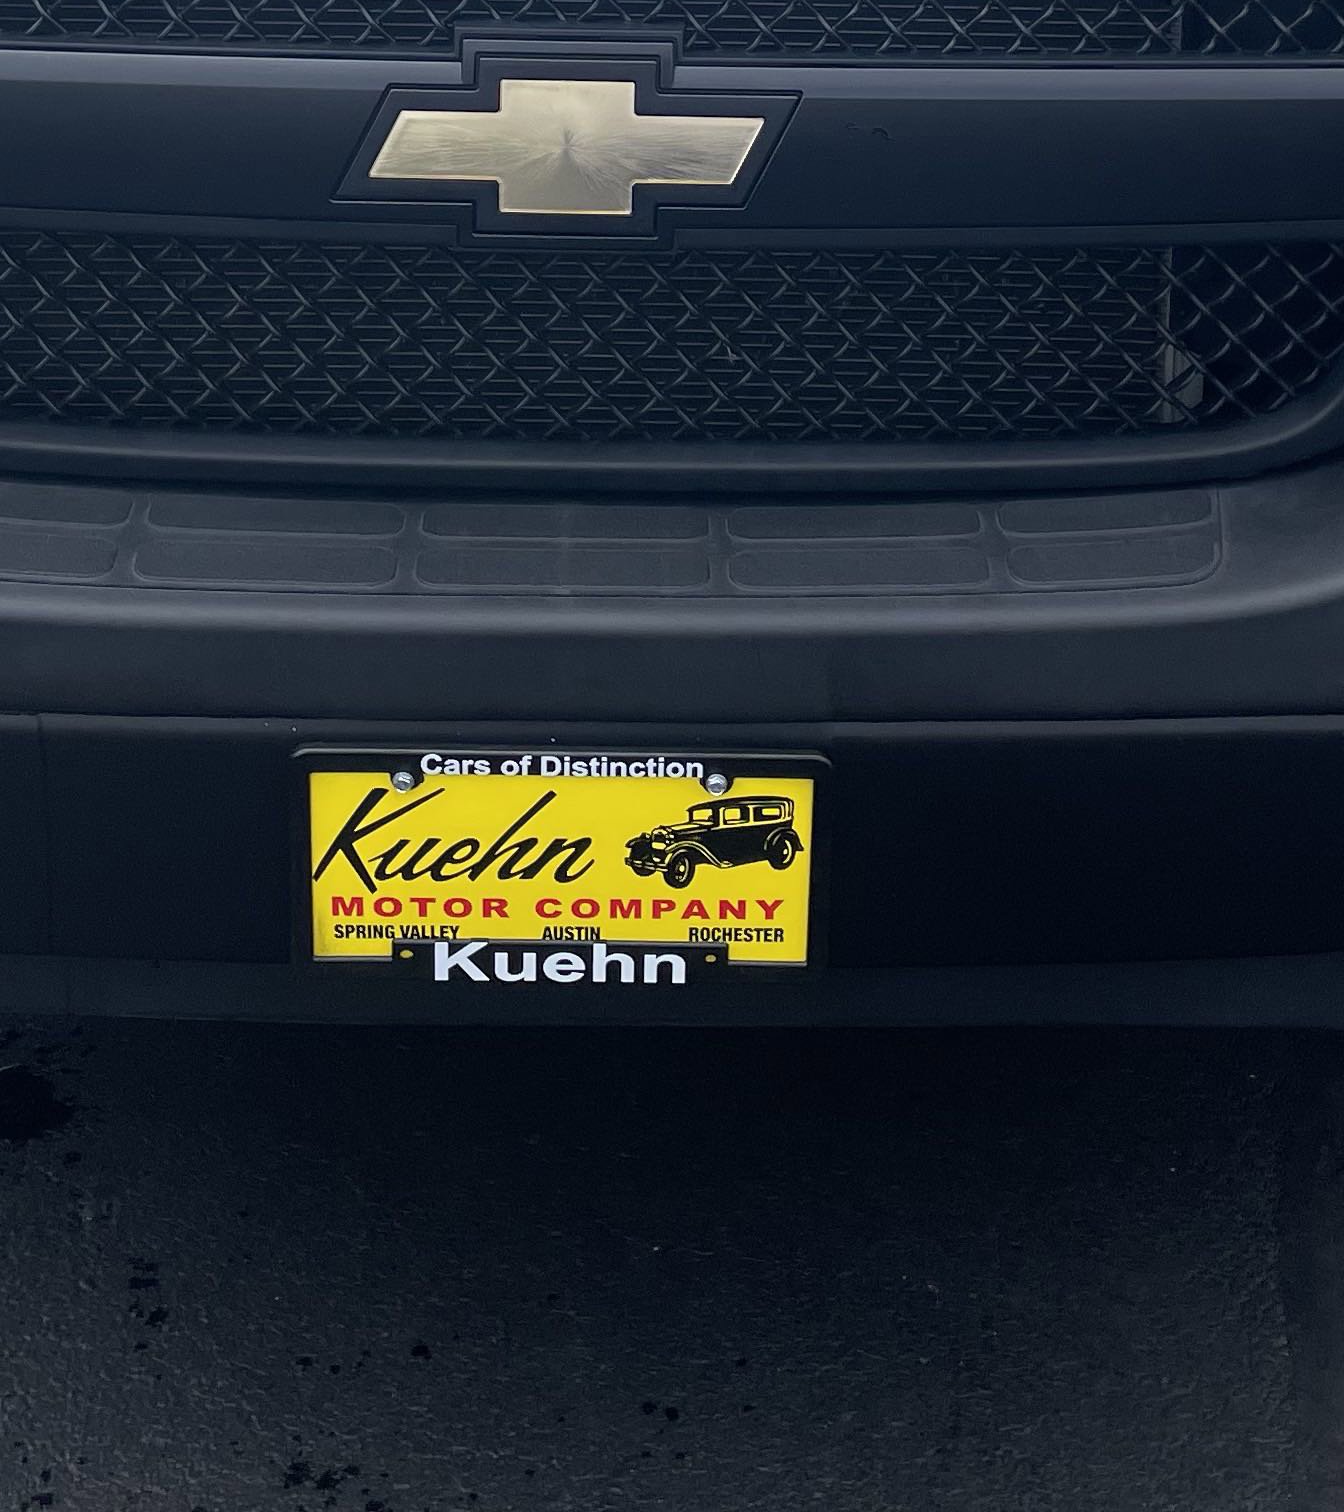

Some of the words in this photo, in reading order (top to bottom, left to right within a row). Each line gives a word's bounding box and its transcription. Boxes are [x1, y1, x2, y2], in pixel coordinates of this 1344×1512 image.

[420, 753, 491, 776] Cars
[500, 754, 533, 777] of
[540, 755, 704, 779] Distinction
[312, 788, 594, 895] Kuehn
[331, 896, 510, 918] MOTOR
[535, 898, 785, 920] COMPANY
[334, 924, 395, 939] SPRING
[399, 925, 460, 940] VALLEY
[542, 926, 601, 941] AUSTIN
[688, 927, 785, 943] ROCHESTER
[433, 941, 686, 984] Kuehn
